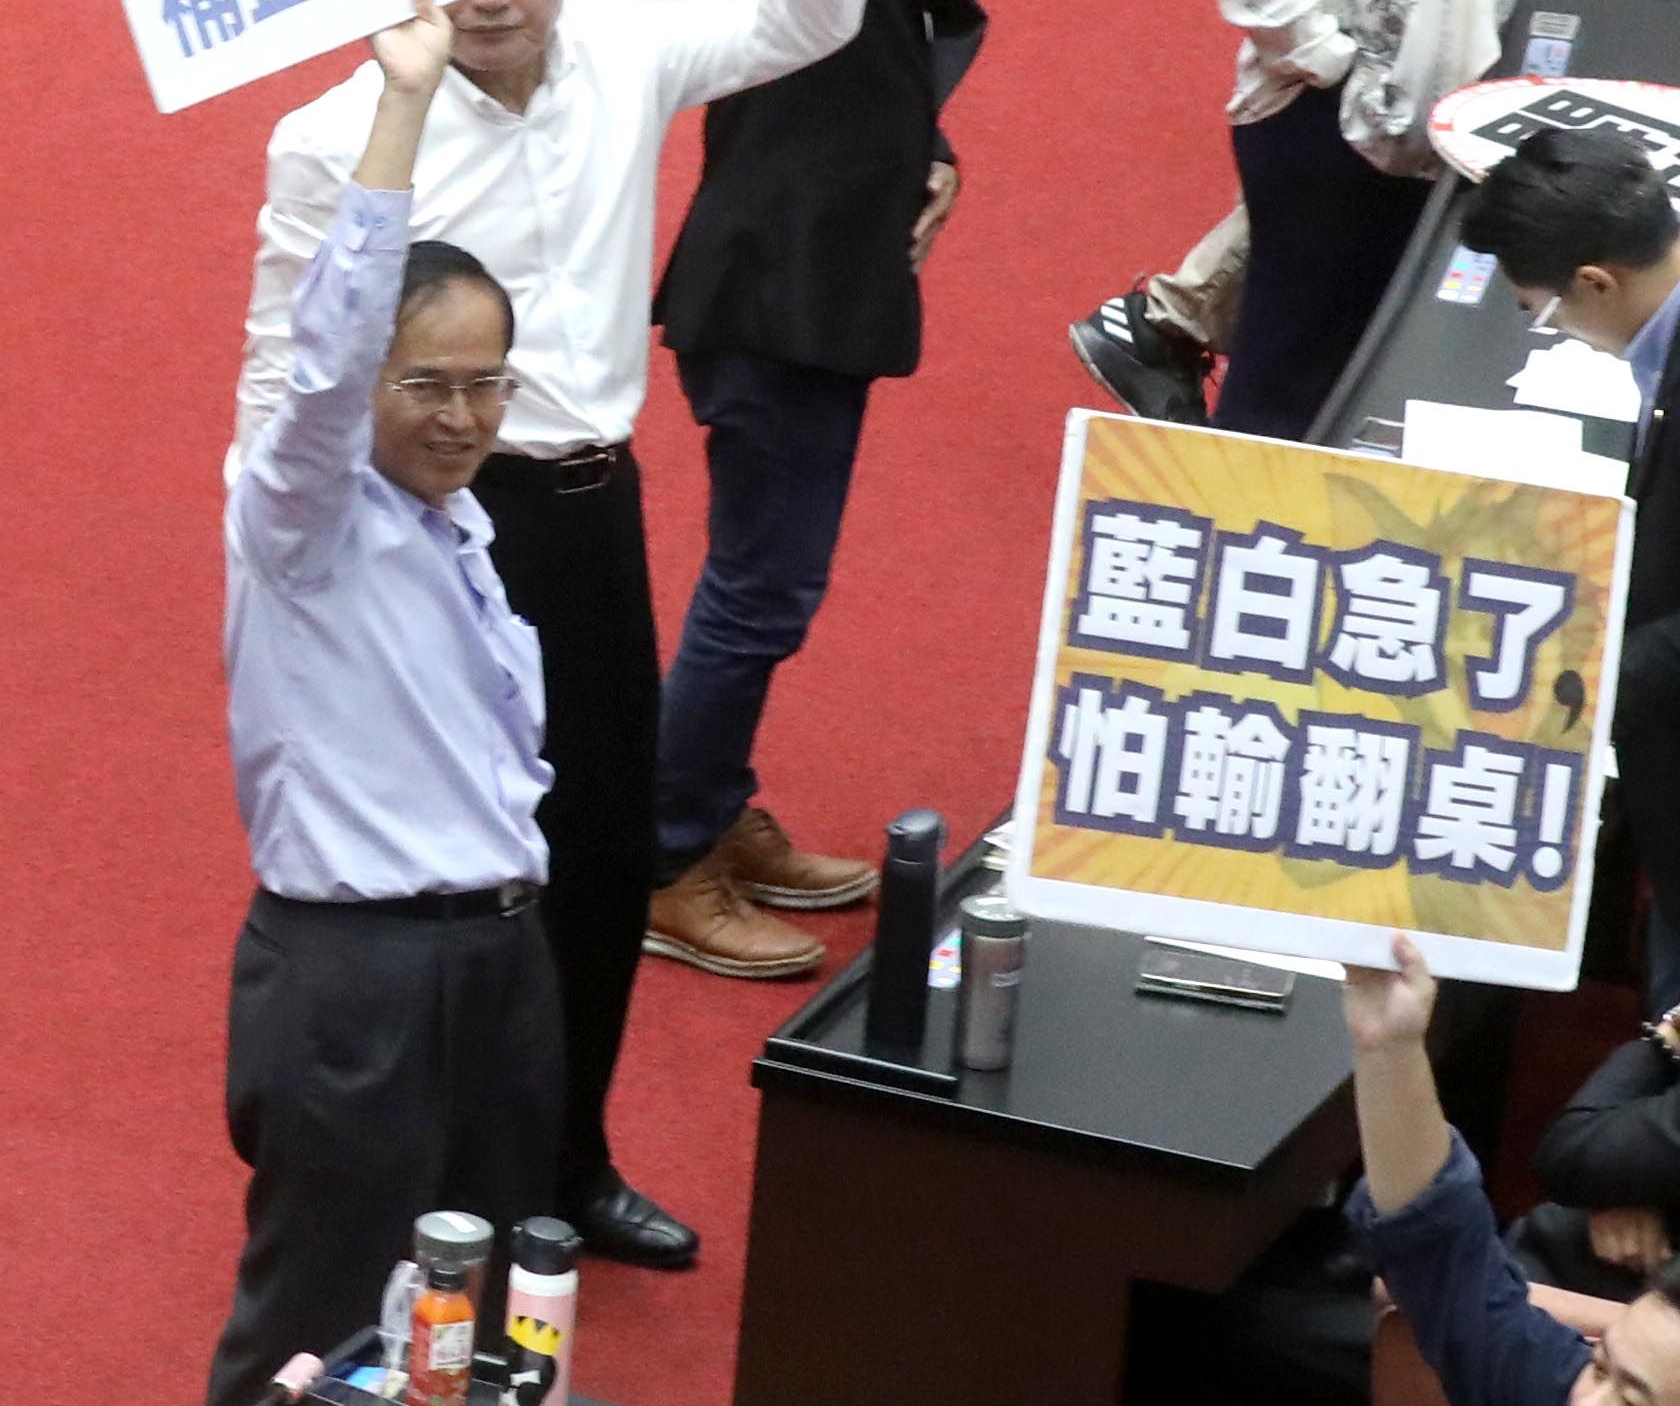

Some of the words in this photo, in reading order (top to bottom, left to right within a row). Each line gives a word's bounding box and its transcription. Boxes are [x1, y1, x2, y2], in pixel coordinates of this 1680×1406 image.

[1070, 497, 1586, 729] 藍白急了，
[1052, 675, 1580, 889] 怕輸翻桌！
